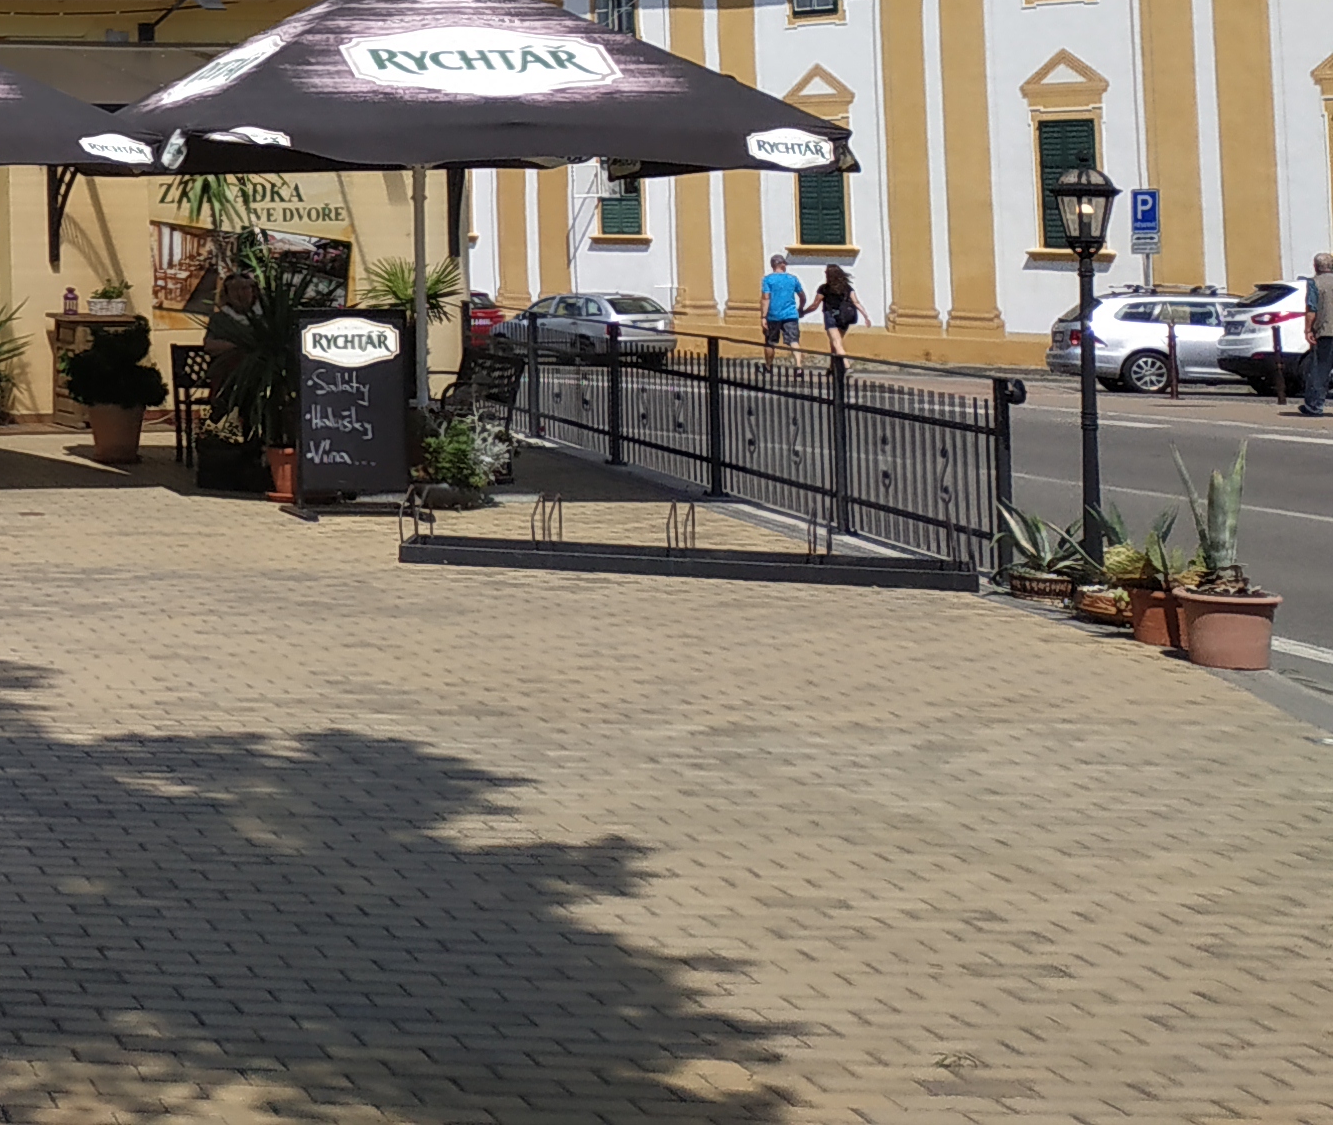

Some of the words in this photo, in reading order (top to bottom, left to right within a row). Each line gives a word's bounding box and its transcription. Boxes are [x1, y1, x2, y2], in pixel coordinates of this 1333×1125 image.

[367, 44, 606, 76] RYCHTÁŘ
[756, 139, 830, 160] RYCHTÁŘ
[281, 203, 346, 223] DVOŘE
[1136, 194, 1153, 220] P
[311, 329, 395, 354] RYCHTÁŘ
